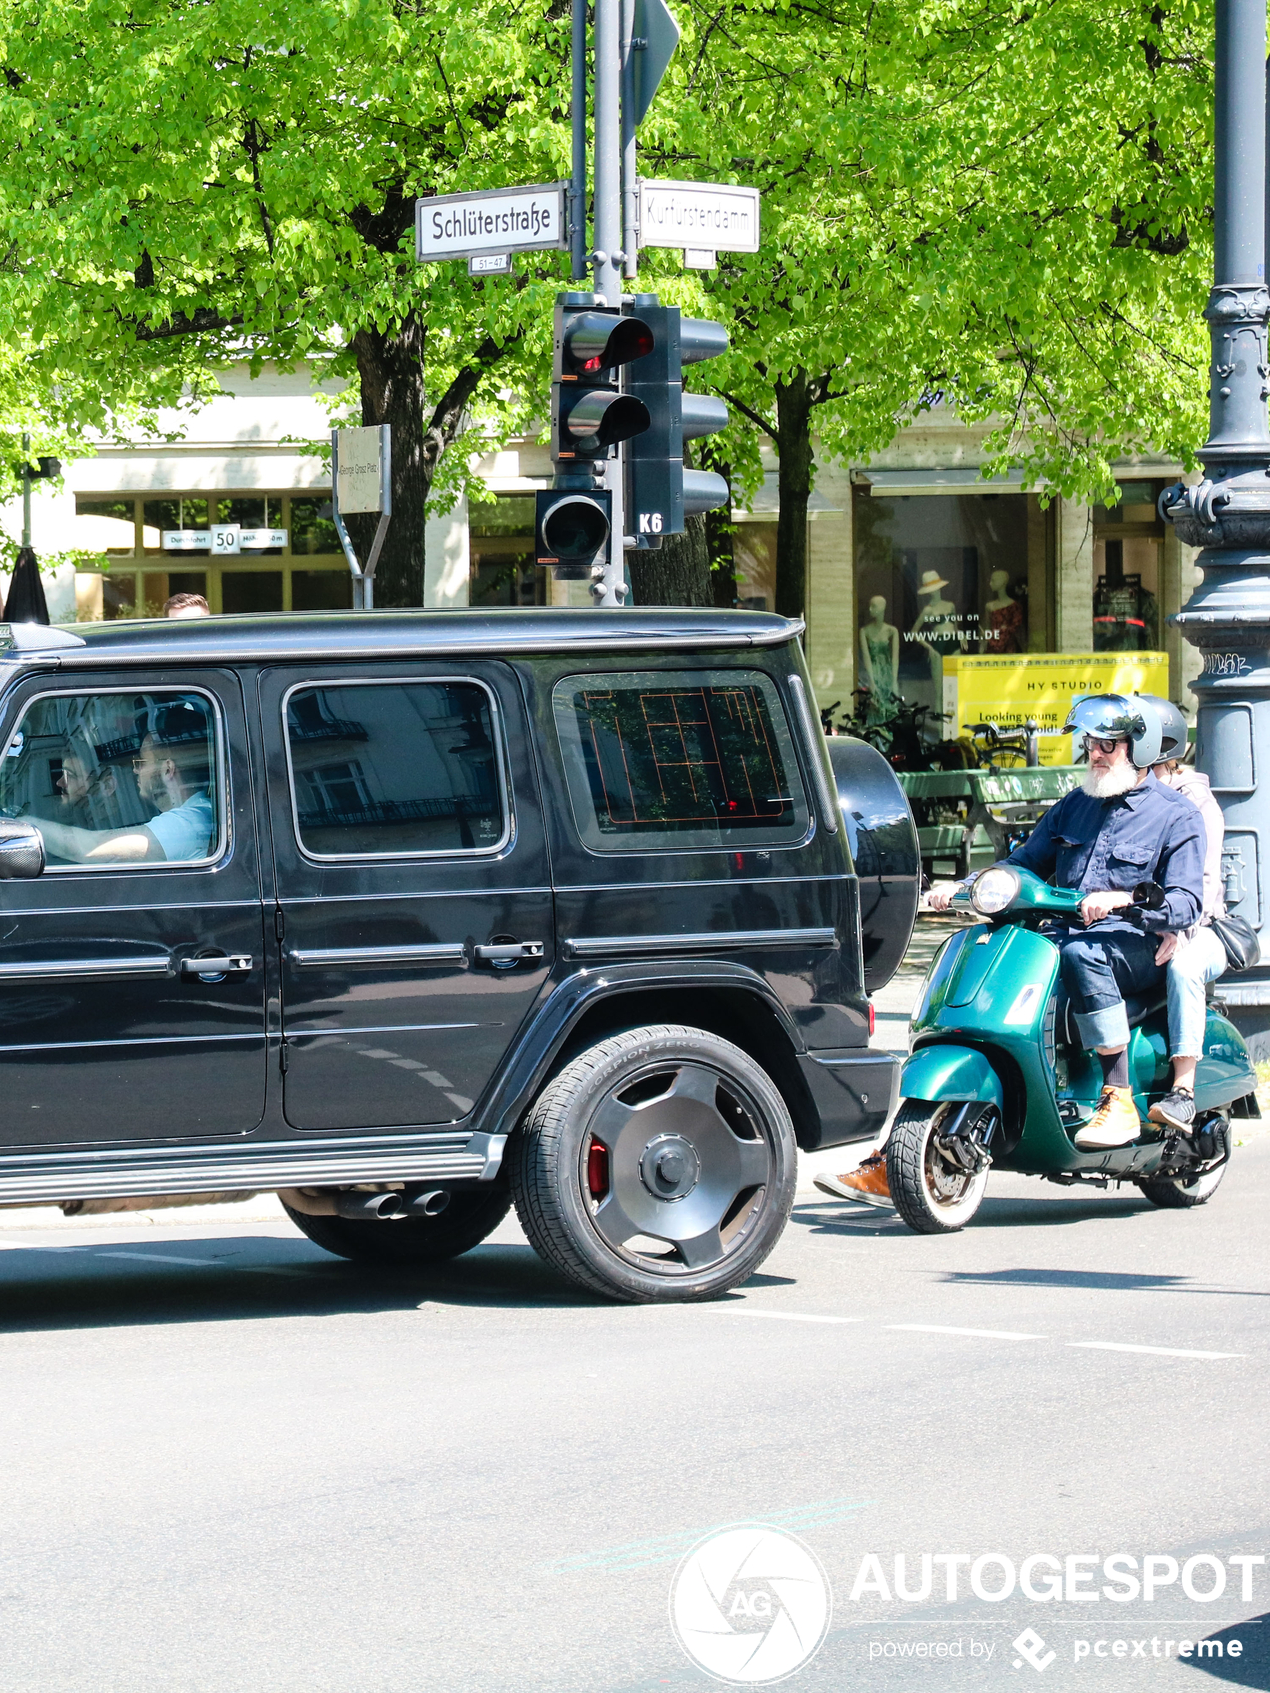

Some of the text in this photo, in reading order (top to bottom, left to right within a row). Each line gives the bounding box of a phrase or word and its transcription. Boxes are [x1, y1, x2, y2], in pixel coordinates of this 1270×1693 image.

[432, 201, 551, 239] Schlüterstraße
[647, 197, 750, 230] Kurfürstendamm
[340, 465, 354, 477] George
[639, 512, 662, 533] K6
[216, 532, 235, 546] 50
[944, 614, 963, 623] you
[967, 613, 979, 621] on
[903, 628, 1000, 642] WWW.DIBEL.DE
[1027, 680, 1103, 691] HY STUDIO
[979, 712, 1058, 722] Looking young
[654, 1040, 700, 1049] ZERO
